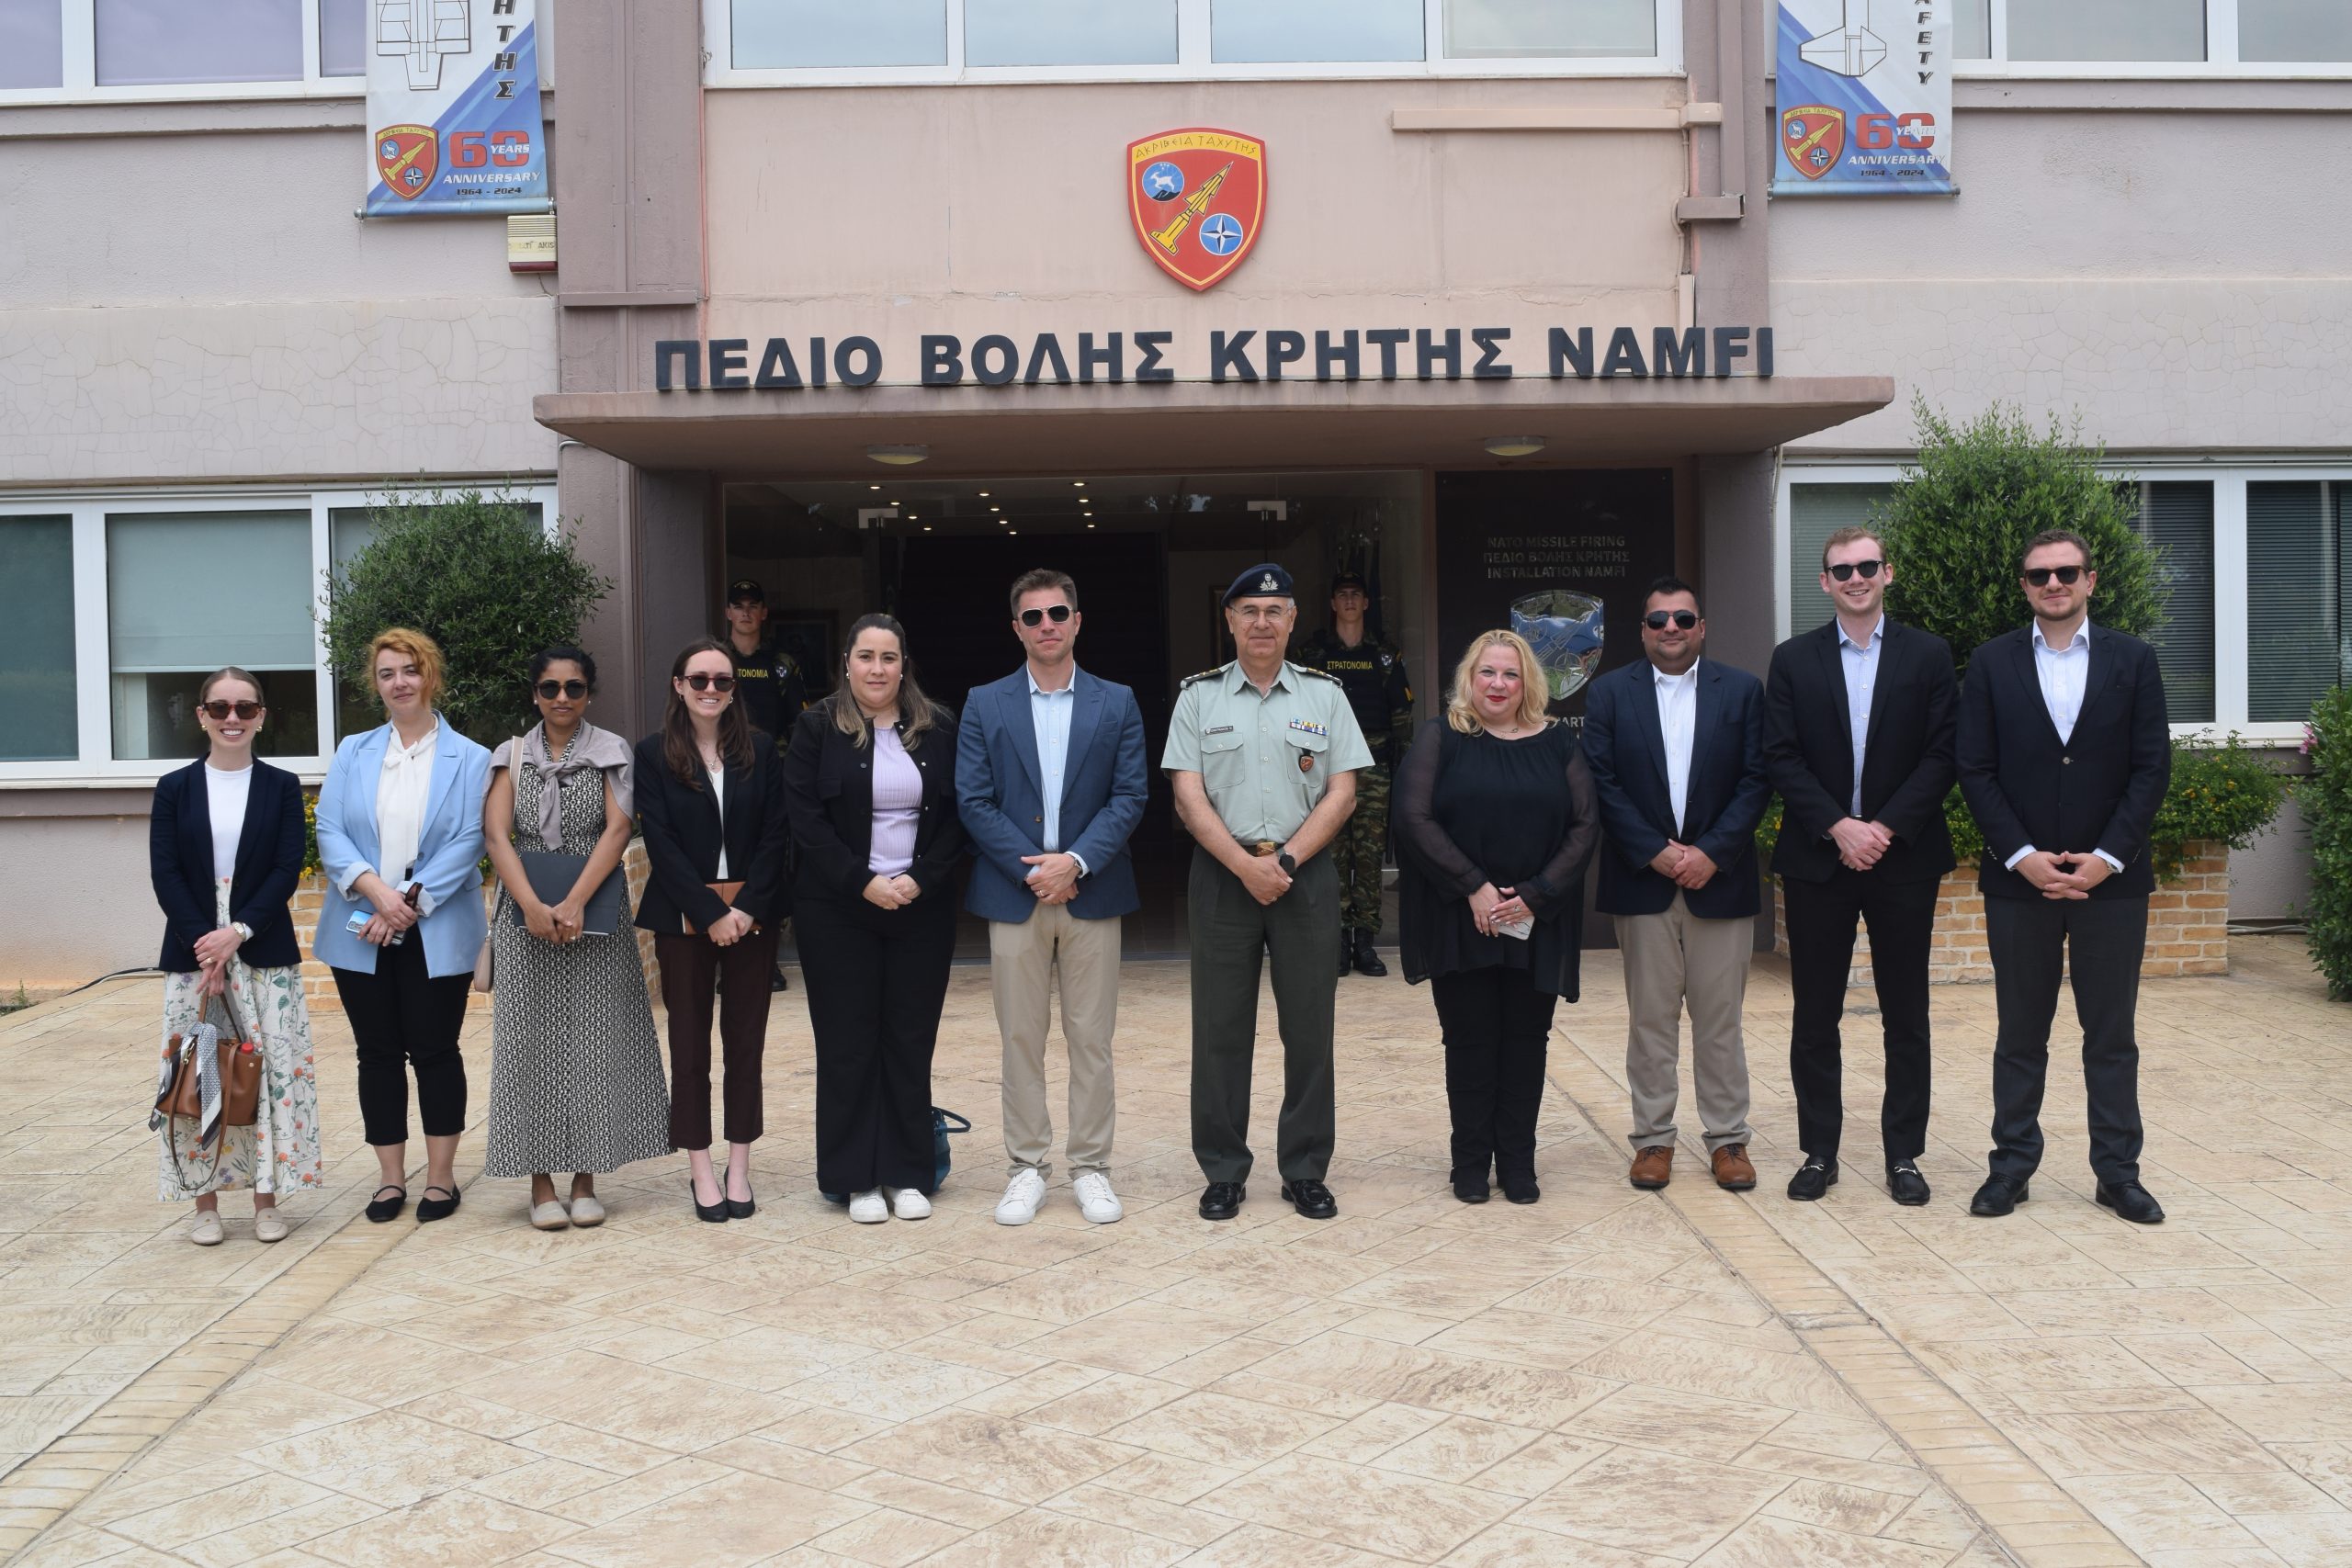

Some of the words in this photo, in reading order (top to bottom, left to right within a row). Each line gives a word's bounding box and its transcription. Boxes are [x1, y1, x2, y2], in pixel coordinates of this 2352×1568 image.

[1856, 113, 1935, 149] 60
[1896, 126, 1937, 136] YEARS
[449, 130, 530, 168] 60
[491, 143, 530, 154] YEARS
[1848, 154, 1946, 165] ANNIVERSARY
[443, 171, 541, 184] ANNIVERSARY
[655, 335, 883, 390] ΠΕΔΙΟ
[921, 331, 1175, 386] ΒΟΛΗΣ
[1210, 327, 1513, 381] ΚΡΗΤΗΣ
[1548, 326, 1774, 378] NAMFI
[1487, 536, 1523, 547] NATO
[1526, 536, 1577, 547] MISSILE
[1581, 536, 1625, 547] FIRING
[1483, 552, 1525, 563] ΠΕΔΙΟ
[1529, 551, 1574, 563] ΒΟΛΗΣ
[1577, 551, 1630, 562] ΚΡΗΤΗΣ
[1487, 567, 1581, 579] INSTALLATION
[1586, 566, 1625, 577] NAMFI
[1327, 660, 1373, 670] ΣΤΡΑΤΟΝΟΜΙΑ
[737, 668, 769, 678] ΤΟΝΟΜΙΑ
